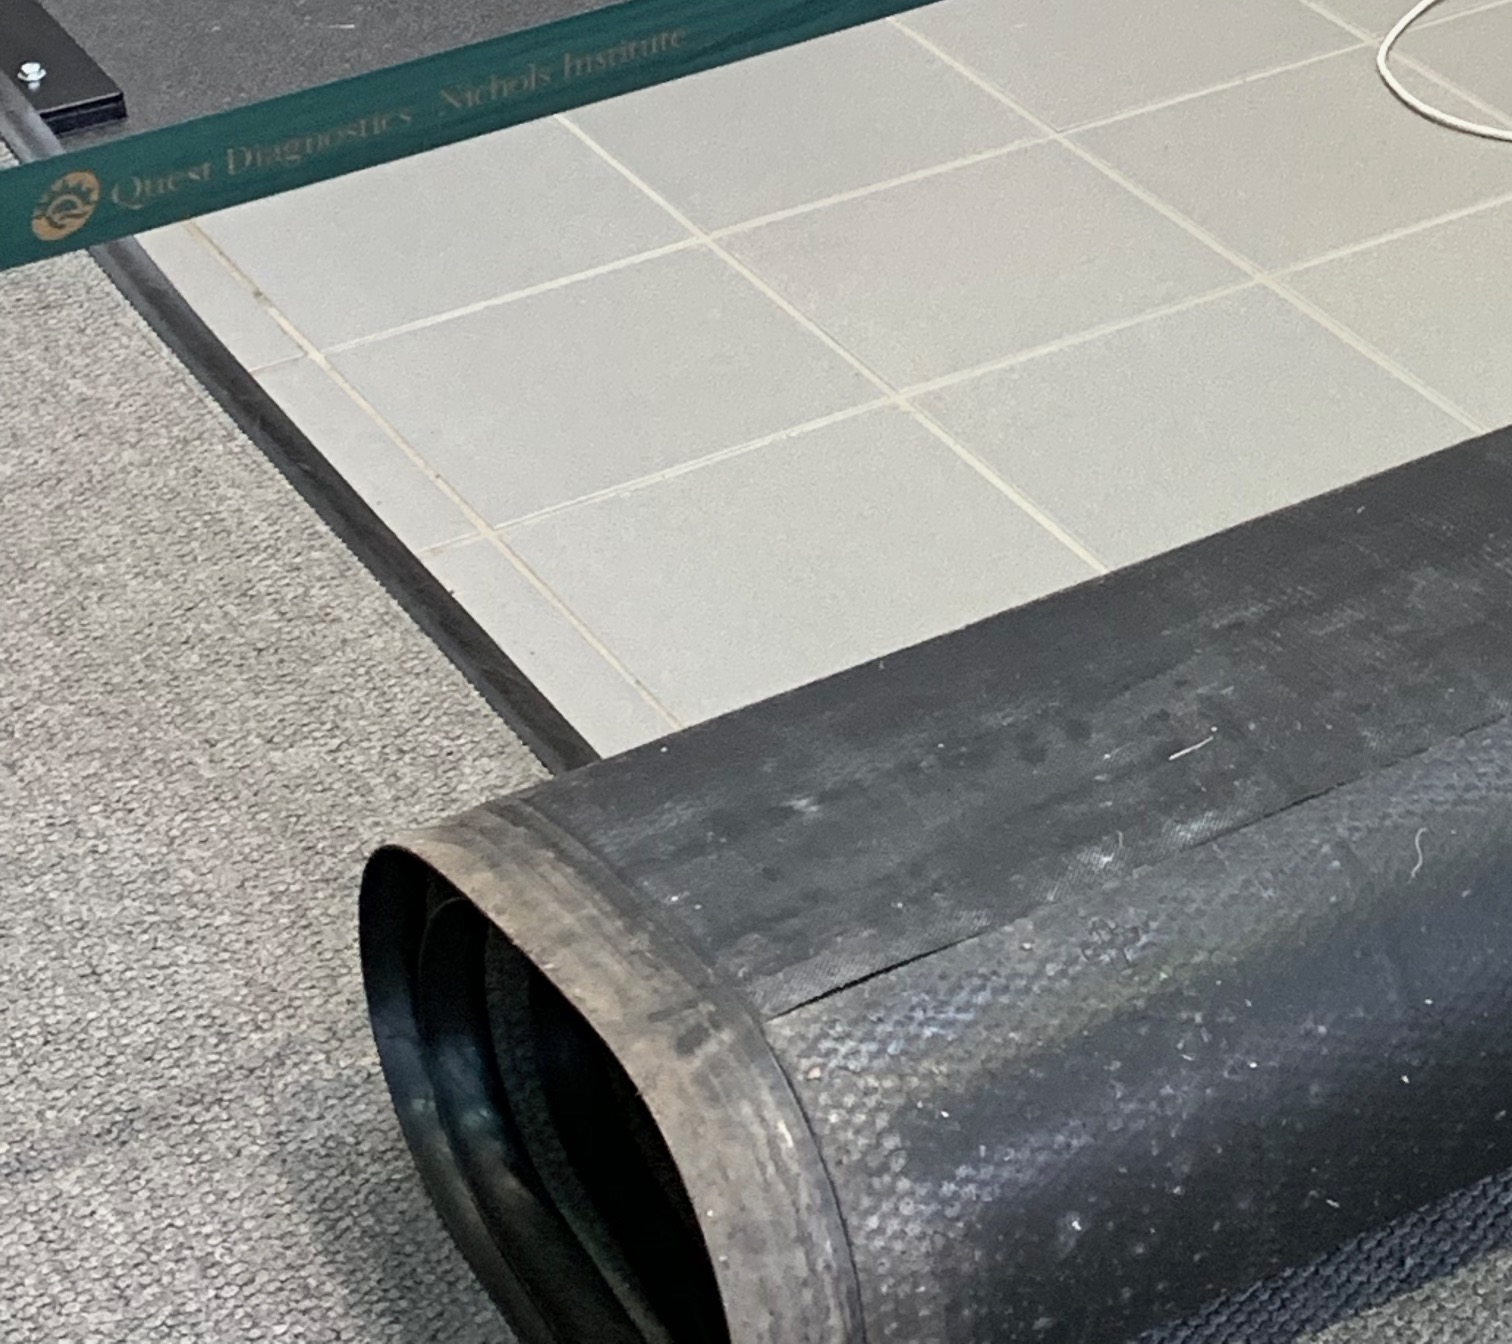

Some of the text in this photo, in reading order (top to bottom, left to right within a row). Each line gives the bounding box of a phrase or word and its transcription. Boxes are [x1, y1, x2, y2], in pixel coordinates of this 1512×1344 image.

[111, 27, 687, 210] Quest Diagnostics Nichols Institute
